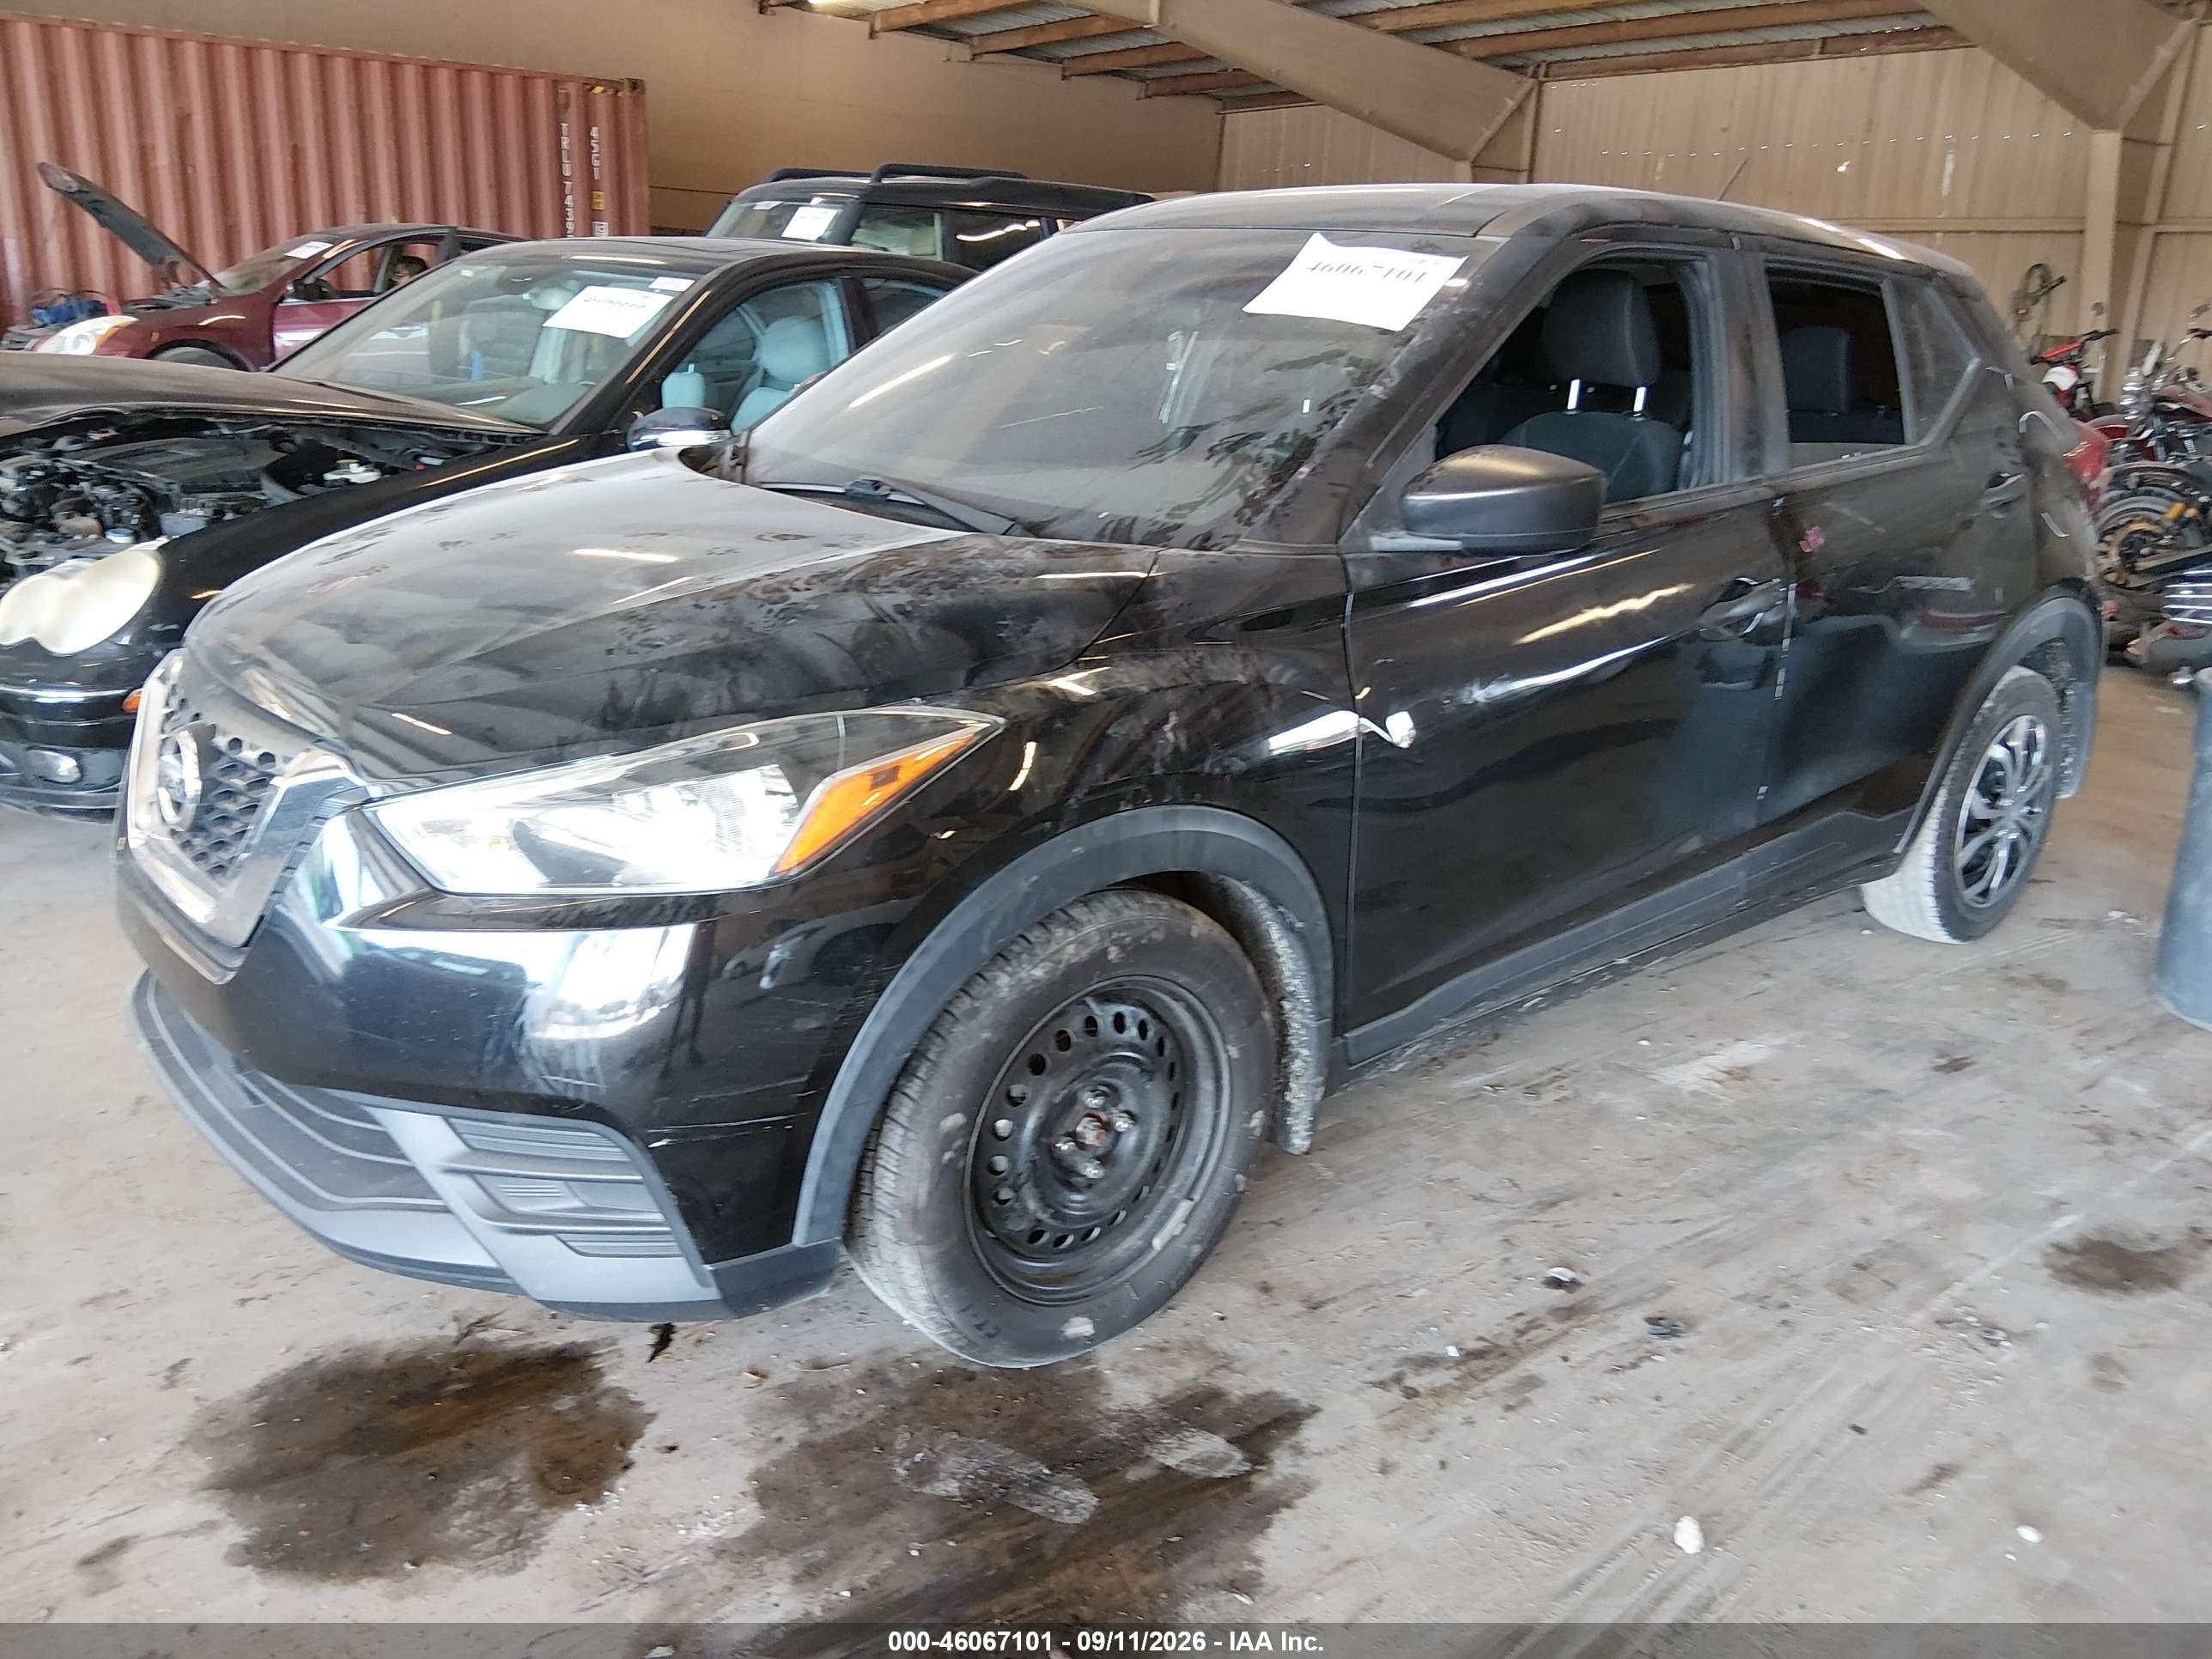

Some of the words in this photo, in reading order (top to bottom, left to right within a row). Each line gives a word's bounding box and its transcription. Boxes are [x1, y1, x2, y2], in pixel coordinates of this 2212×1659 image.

[560, 122, 572, 177] TRLU
[589, 126, 601, 180] 45G1
[562, 180, 575, 237] 7439
